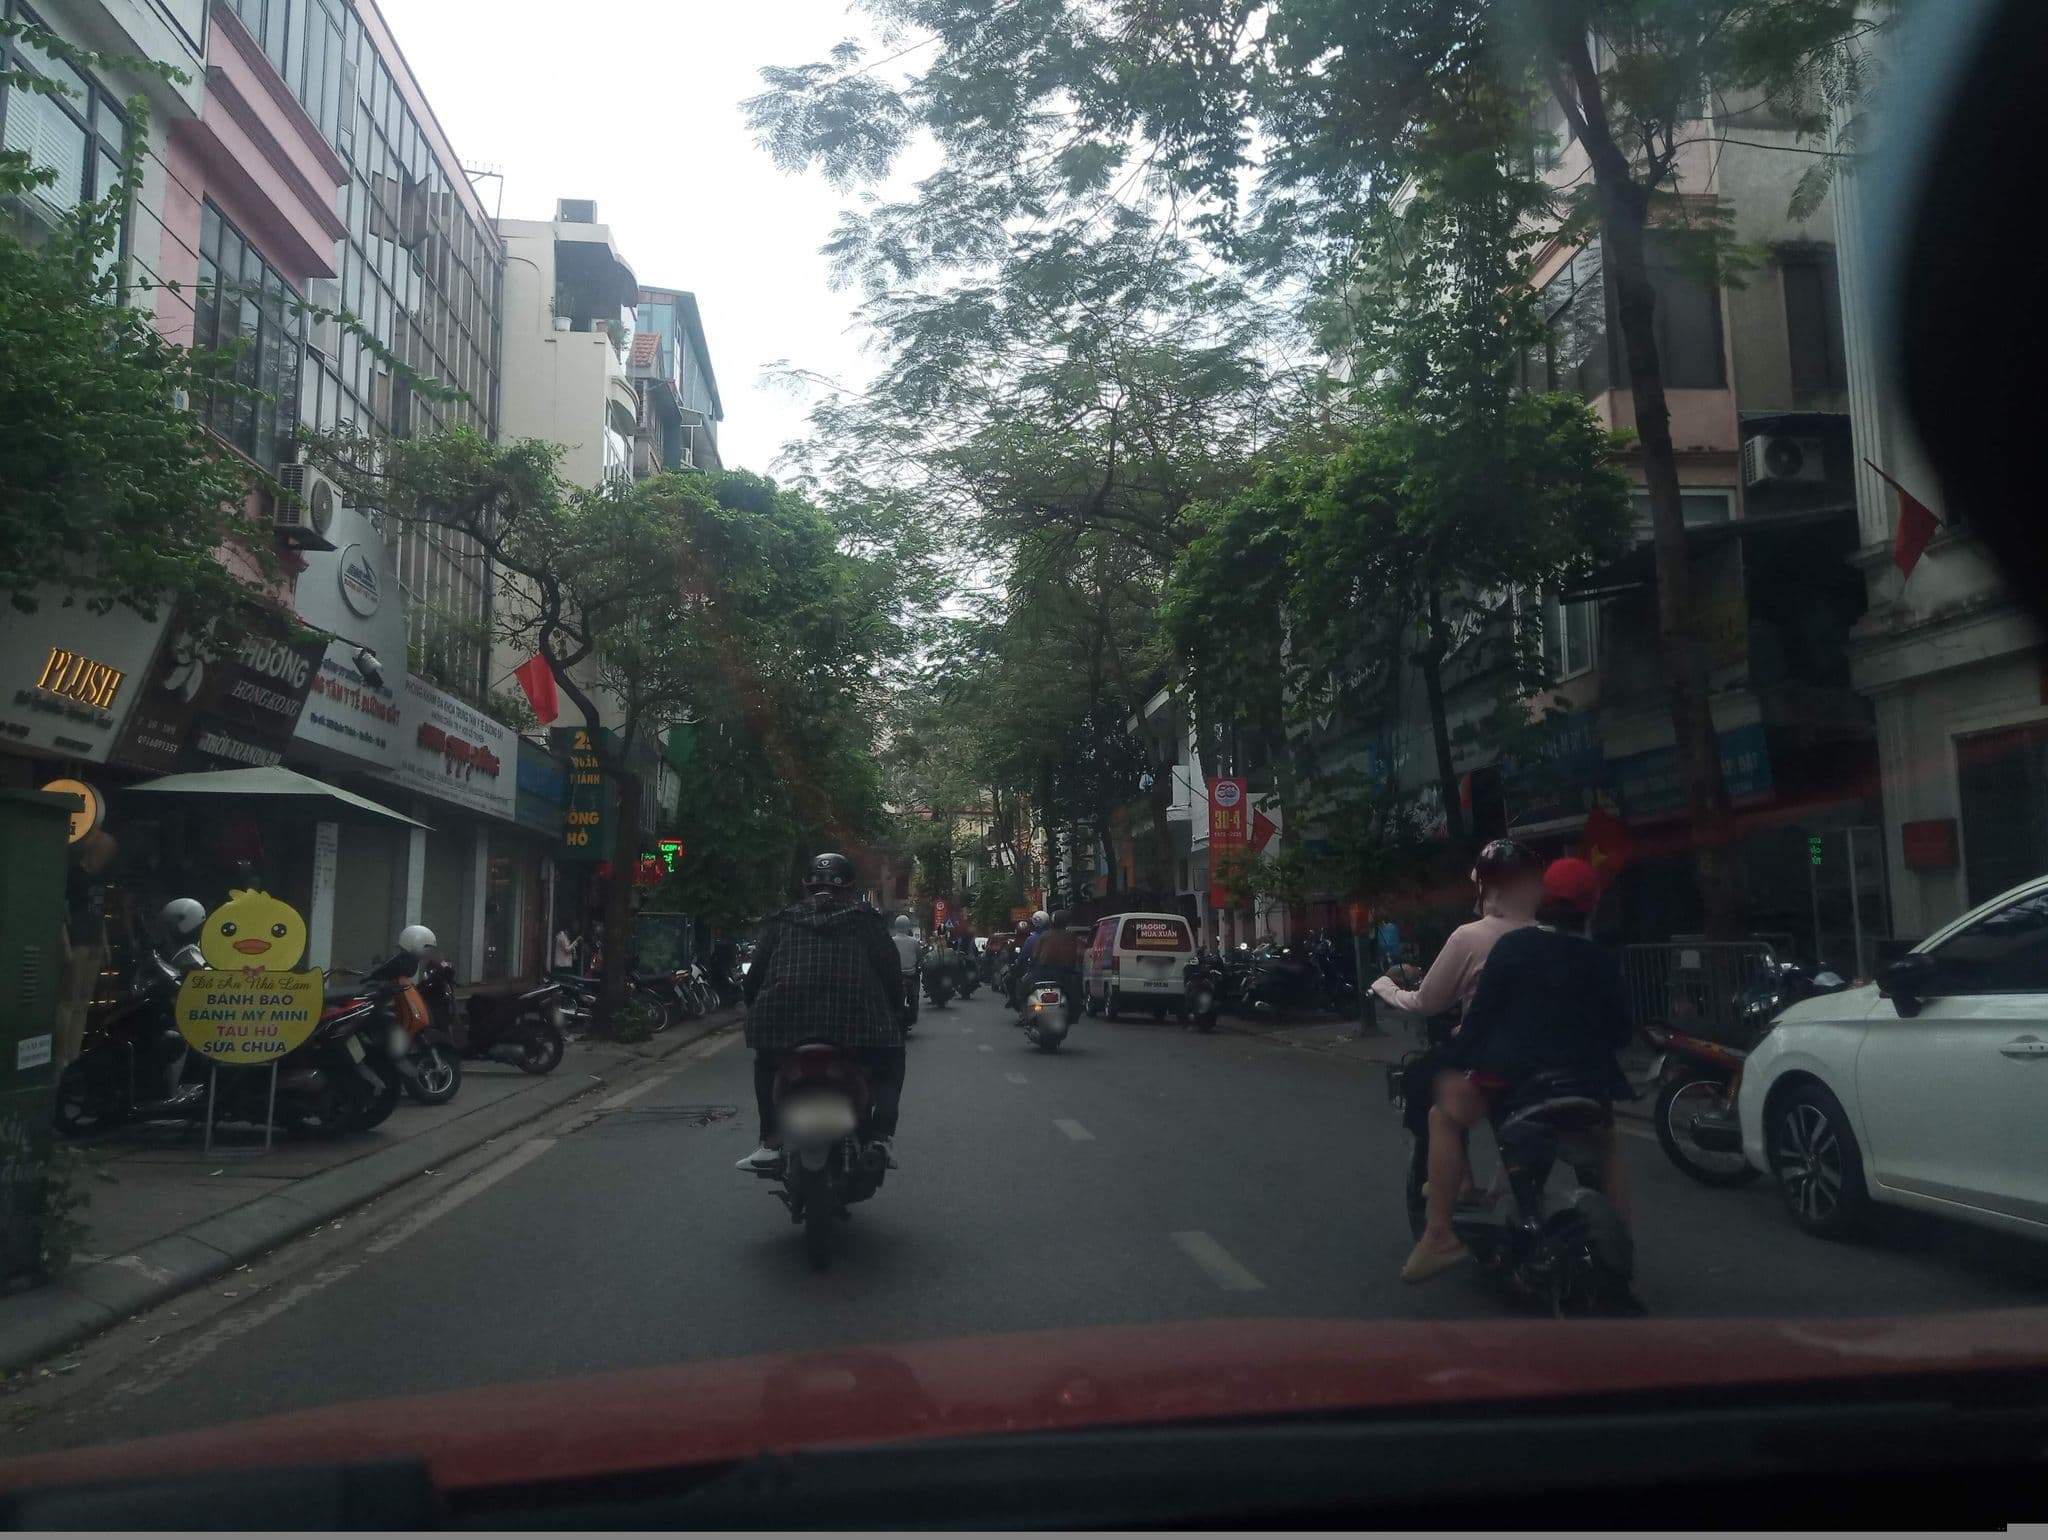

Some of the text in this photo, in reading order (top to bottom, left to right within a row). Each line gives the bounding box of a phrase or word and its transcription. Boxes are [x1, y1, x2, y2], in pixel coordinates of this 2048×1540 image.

[37, 648, 126, 710] PLUSH
[1136, 923, 1167, 931] PIAGGIO
[259, 994, 294, 1006] BAO
[270, 1010, 309, 1021] MINI
[241, 1041, 287, 1053] CHUA
